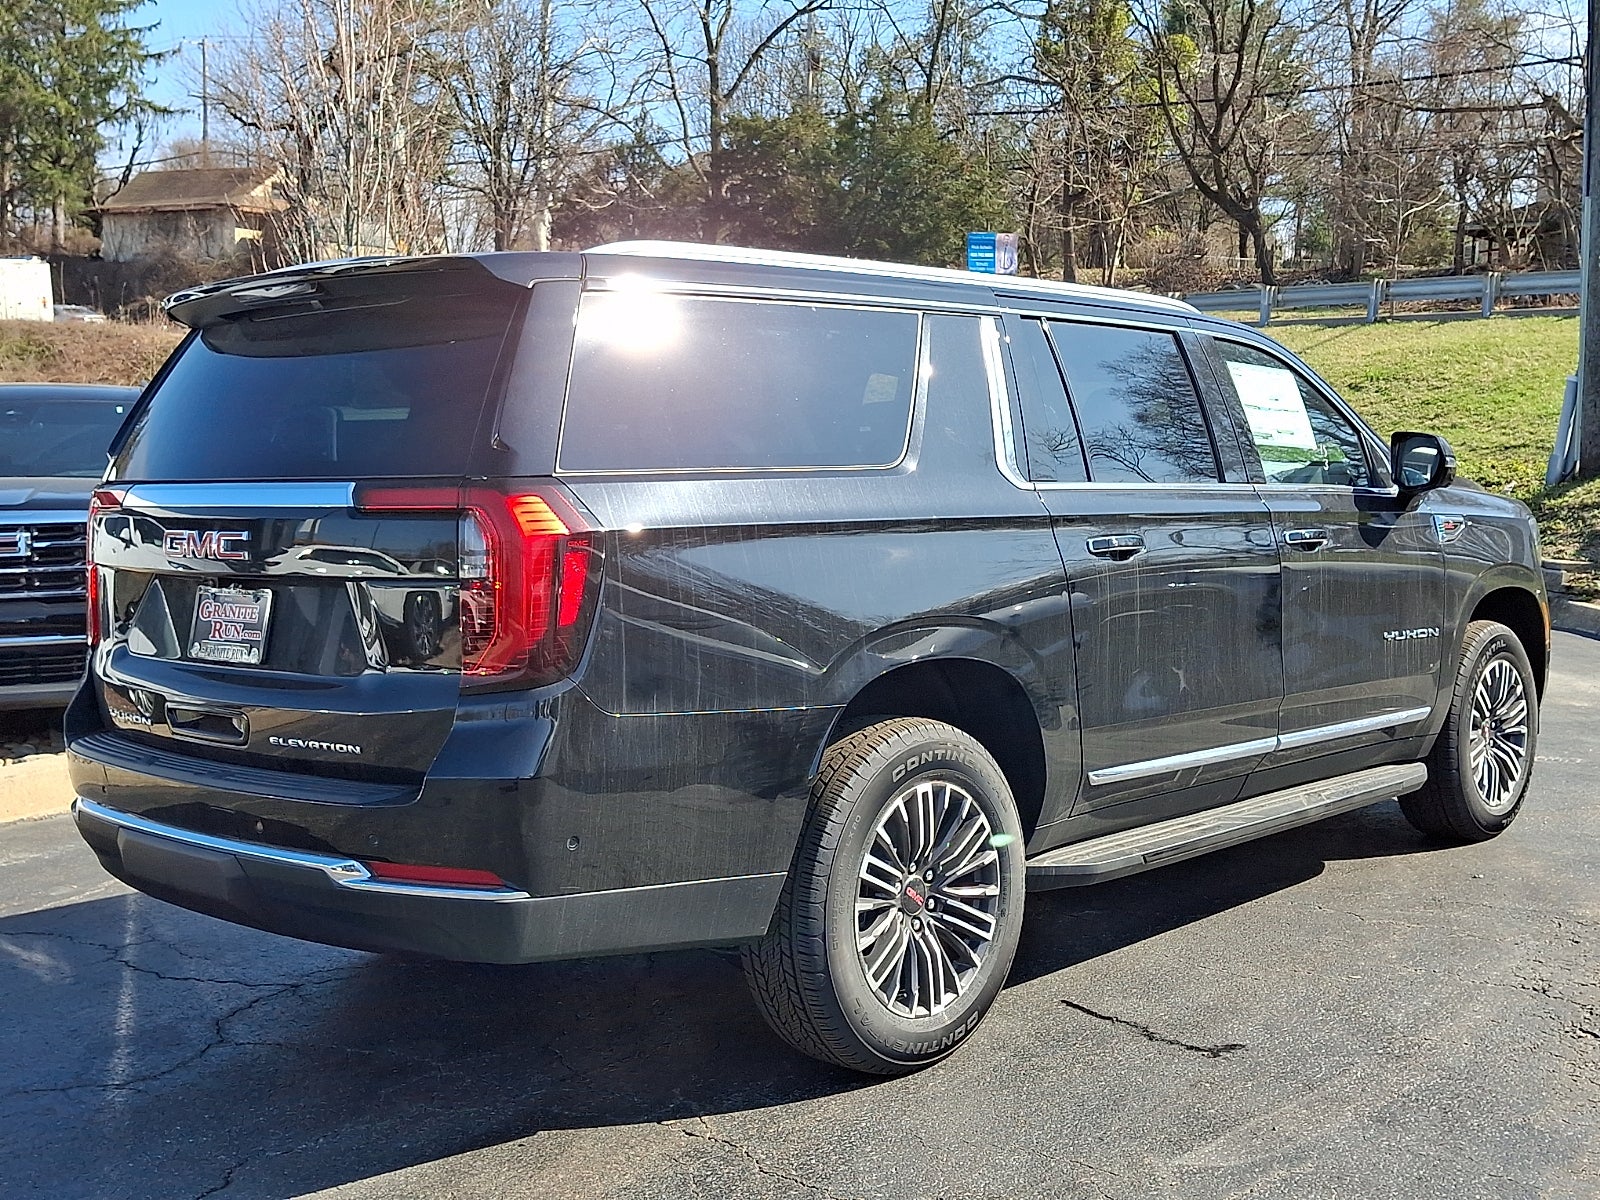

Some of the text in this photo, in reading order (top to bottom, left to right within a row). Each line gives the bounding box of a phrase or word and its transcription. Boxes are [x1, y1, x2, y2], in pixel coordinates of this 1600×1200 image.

[162, 530, 249, 560] GMC
[200, 601, 259, 622] GRANITE
[1383, 627, 1440, 641] YUKON
[108, 705, 153, 726] YUKON
[268, 736, 362, 754] ELEVATION
[905, 886, 924, 906] GMC
[853, 997, 979, 1055] CONTINENTAL
